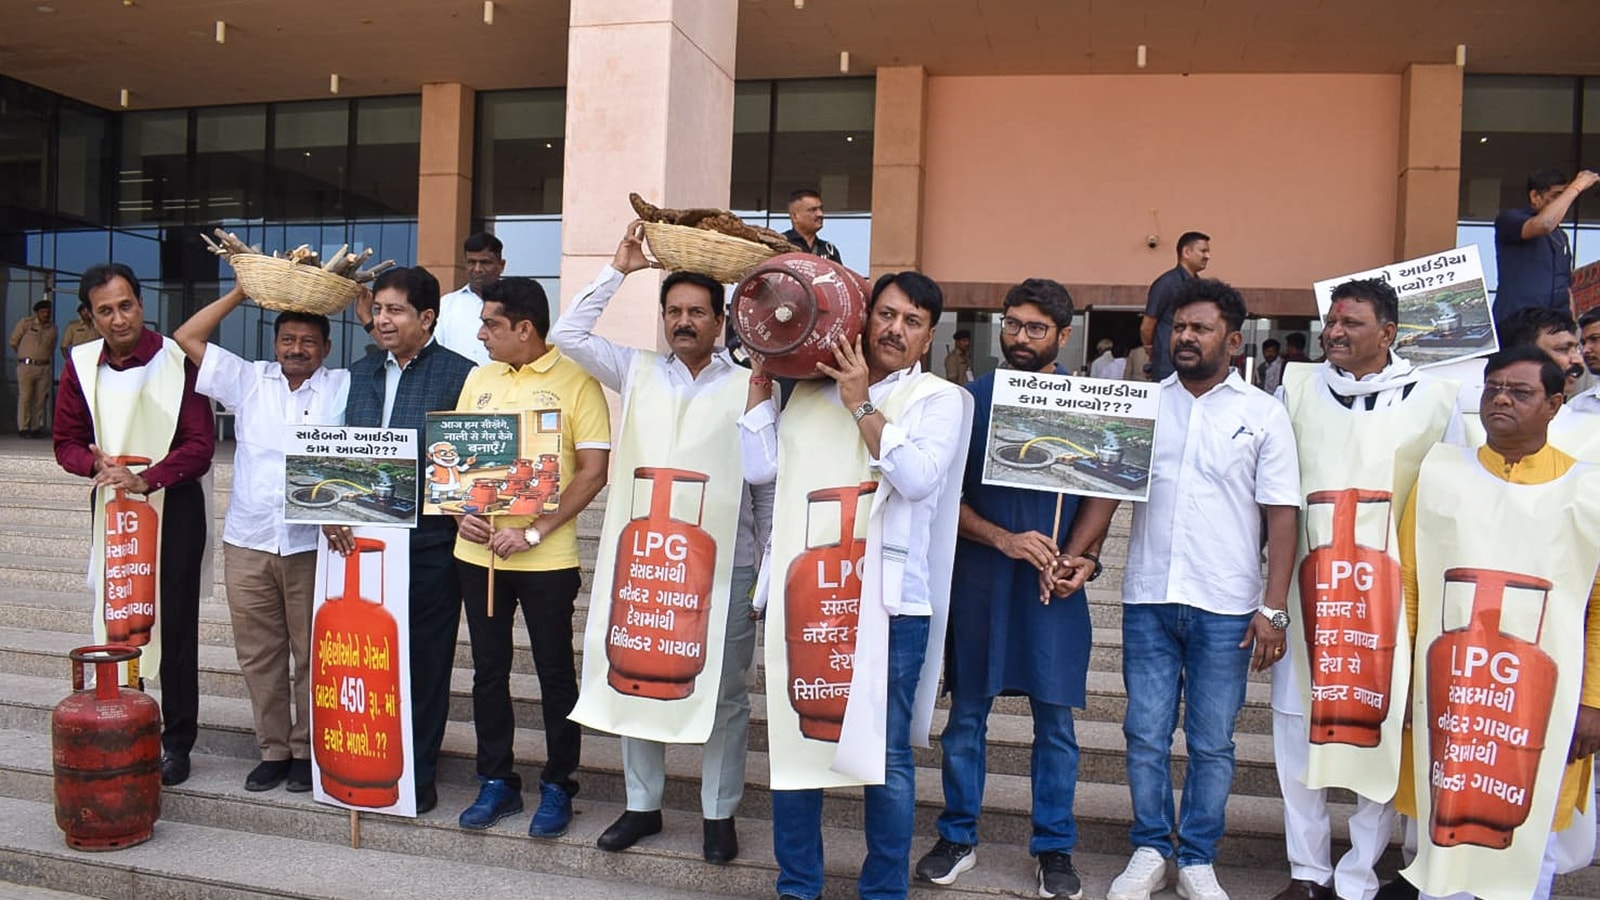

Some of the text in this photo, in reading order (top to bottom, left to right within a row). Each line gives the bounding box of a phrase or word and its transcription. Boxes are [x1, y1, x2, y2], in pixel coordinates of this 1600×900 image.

[755, 321, 772, 341] 15.8
[1008, 375, 1148, 399] સાહેબનો આઈડીયા
[1018, 394, 1133, 413] કામ આવ્યો???
[296, 429, 408, 443] સાહેબનો આઈડીયા
[440, 421, 462, 429] आज
[464, 421, 478, 430] हम
[443, 430, 468, 441] नाली
[470, 431, 479, 441] से
[306, 444, 397, 456] કામ આવ્યો???
[632, 530, 688, 561] LPG
[629, 558, 686, 583] સંસદમાંથી
[1315, 560, 1374, 591] LPG
[656, 590, 699, 609] ગાયબ
[1316, 595, 1366, 619] संसद से
[626, 605, 676, 631] દેશમાંથી
[610, 626, 702, 658] સિલિન્ડર ગાયબ
[803, 620, 849, 643] नरेंदर
[363, 634, 390, 672] ગેસનો
[1319, 651, 1361, 675] देश से
[1450, 644, 1521, 684] LPG
[315, 676, 338, 710] બાટલો
[340, 676, 365, 714] 450
[324, 720, 343, 753] ક્યારે
[1473, 716, 1529, 746] ગાયબ
[1470, 773, 1525, 806] ગાયબ
